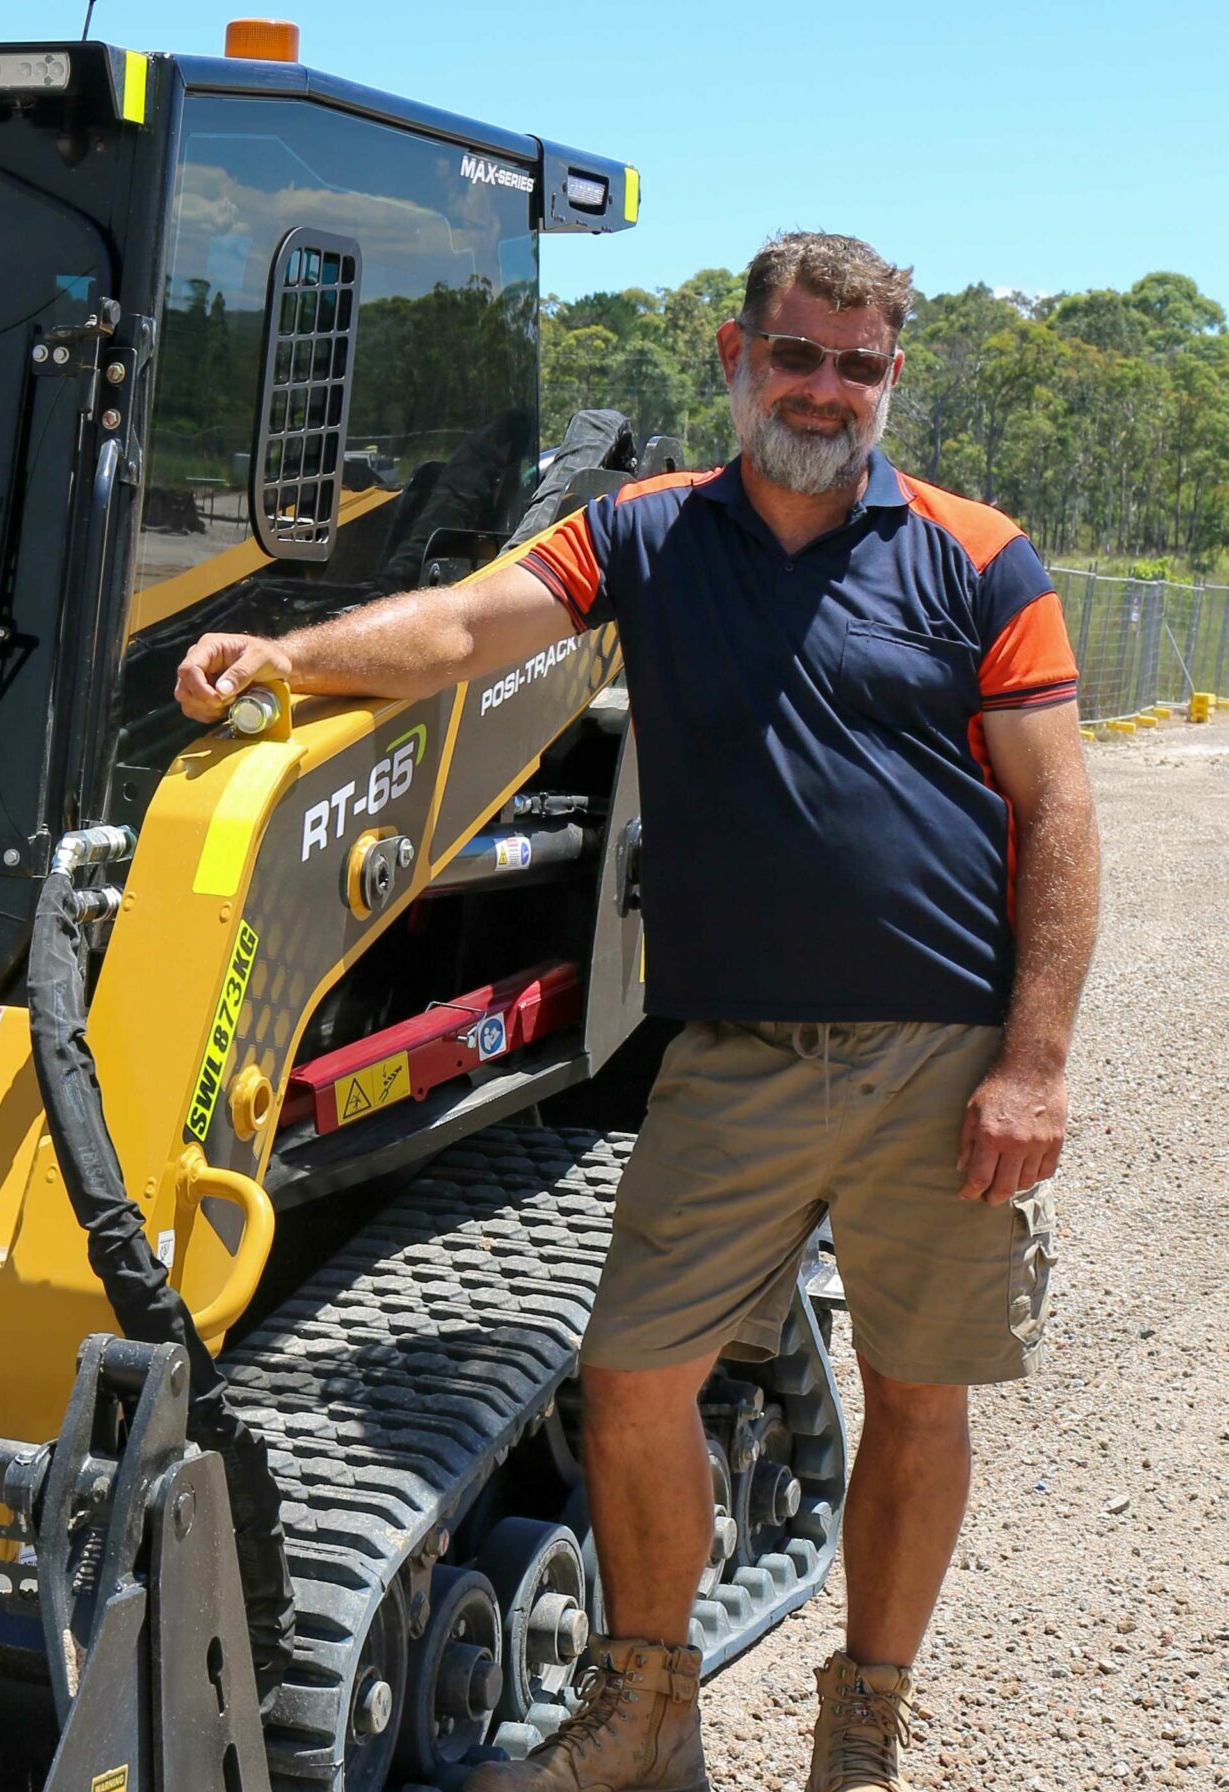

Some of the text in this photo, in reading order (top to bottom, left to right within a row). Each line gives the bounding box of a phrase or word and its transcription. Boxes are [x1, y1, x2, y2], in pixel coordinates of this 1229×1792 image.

[460, 154, 535, 193] MAX-SERIES
[480, 635, 577, 717] POSI-TRACK
[300, 740, 415, 863] RT-65
[189, 925, 257, 1136] SWL 873KG
